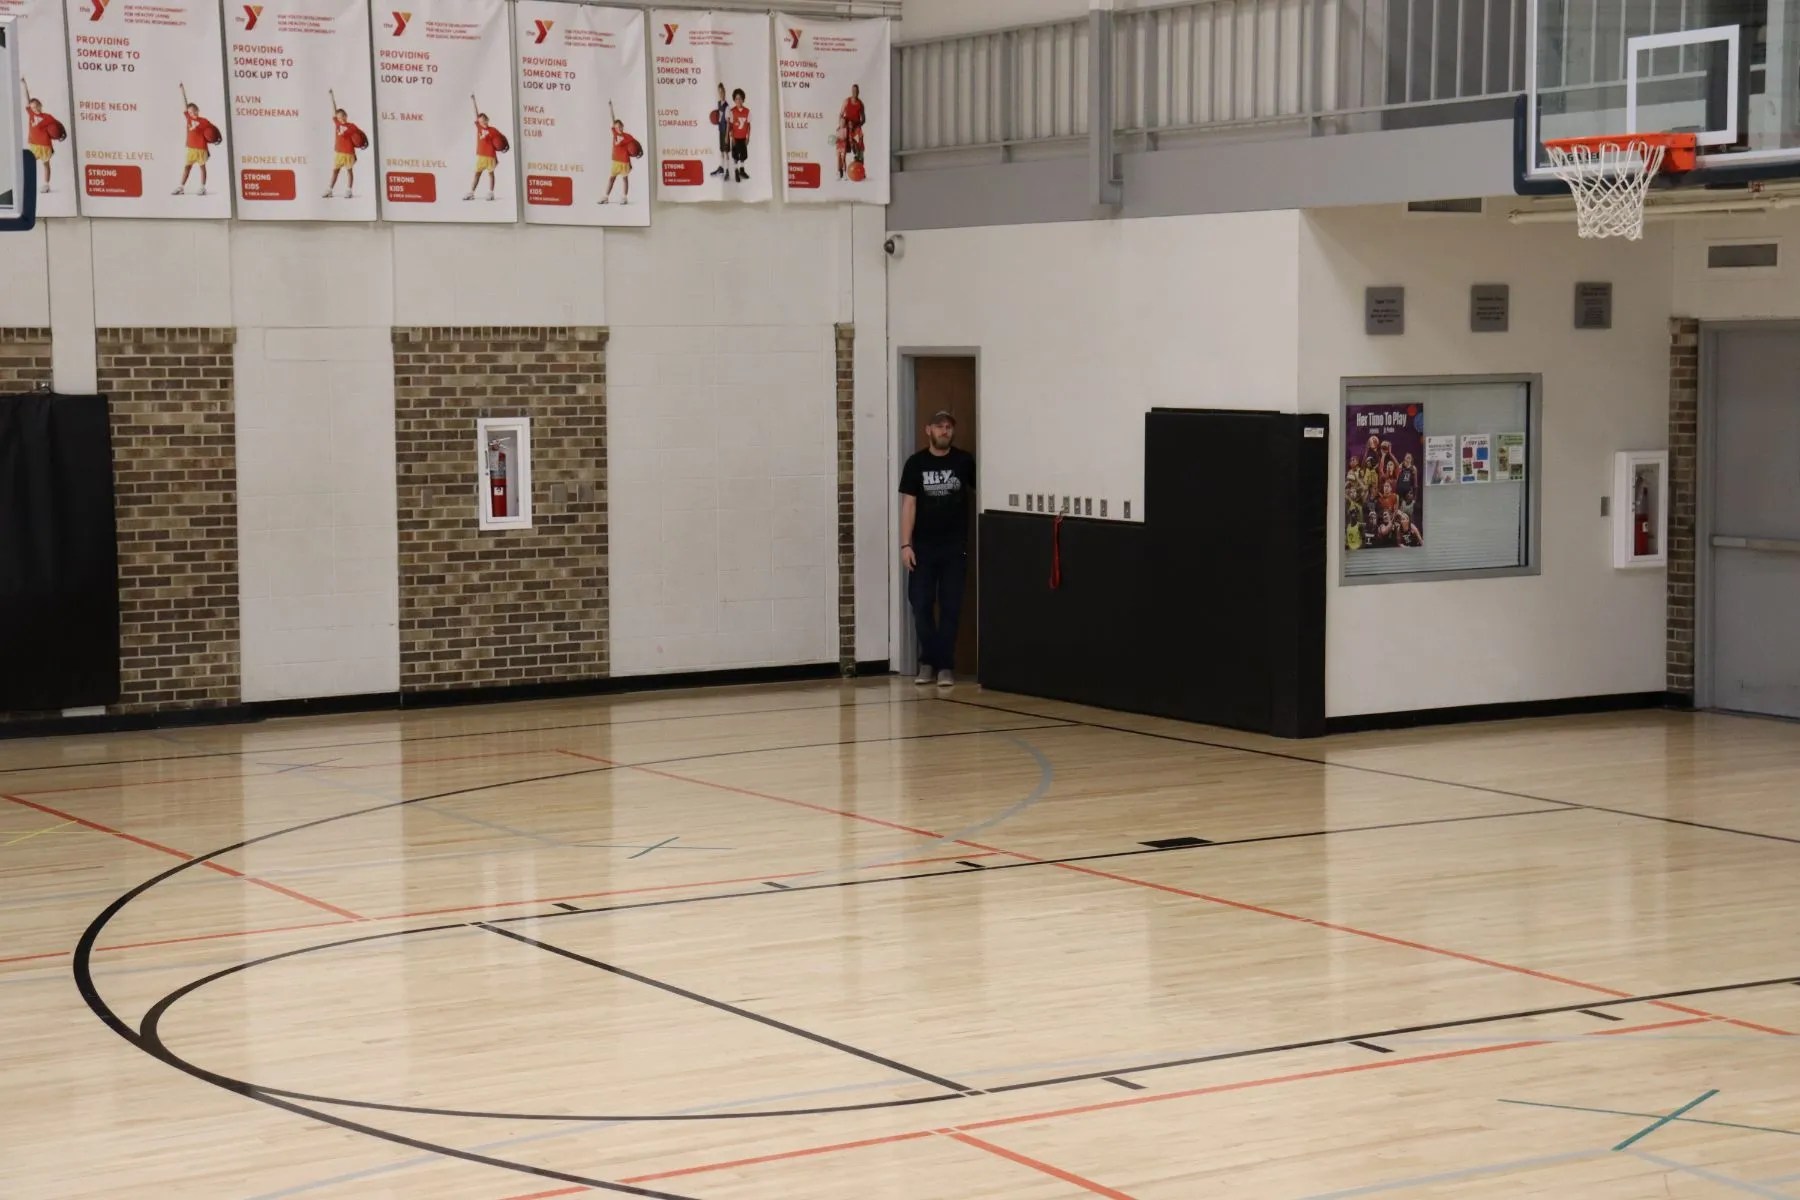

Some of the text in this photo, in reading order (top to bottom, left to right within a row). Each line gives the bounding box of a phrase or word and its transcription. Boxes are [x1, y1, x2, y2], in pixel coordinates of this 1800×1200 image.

[76, 35, 130, 46] PROVIDING
[233, 44, 283, 54] PROVIDING
[77, 49, 140, 60] SOMEONE TO
[380, 50, 430, 60] PROVIDING
[234, 58, 293, 66] SOMEONE TO
[522, 57, 567, 67] PROVIDING
[780, 60, 818, 68] PROVIDING
[78, 62, 135, 72] LOOK UP TO
[380, 62, 423, 72] SOMEONE
[234, 70, 257, 78] LOOK
[523, 69, 561, 78] SOMEONE
[381, 75, 403, 83] LOOK
[406, 76, 418, 84] UP
[80, 101, 137, 111] PRIDE NEON
[523, 105, 544, 113] YMCA
[80, 113, 107, 121] SIGNS
[236, 108, 299, 117] SCHOENEMAN
[523, 117, 555, 126] SERVICE
[86, 150, 154, 160] BRONZE LEVEL
[280, 156, 307, 164] LEVEL
[386, 159, 420, 167] BRONZE
[528, 162, 584, 172] BRONZE LEVEL
[1356, 411, 1407, 428] Her Time To Play
